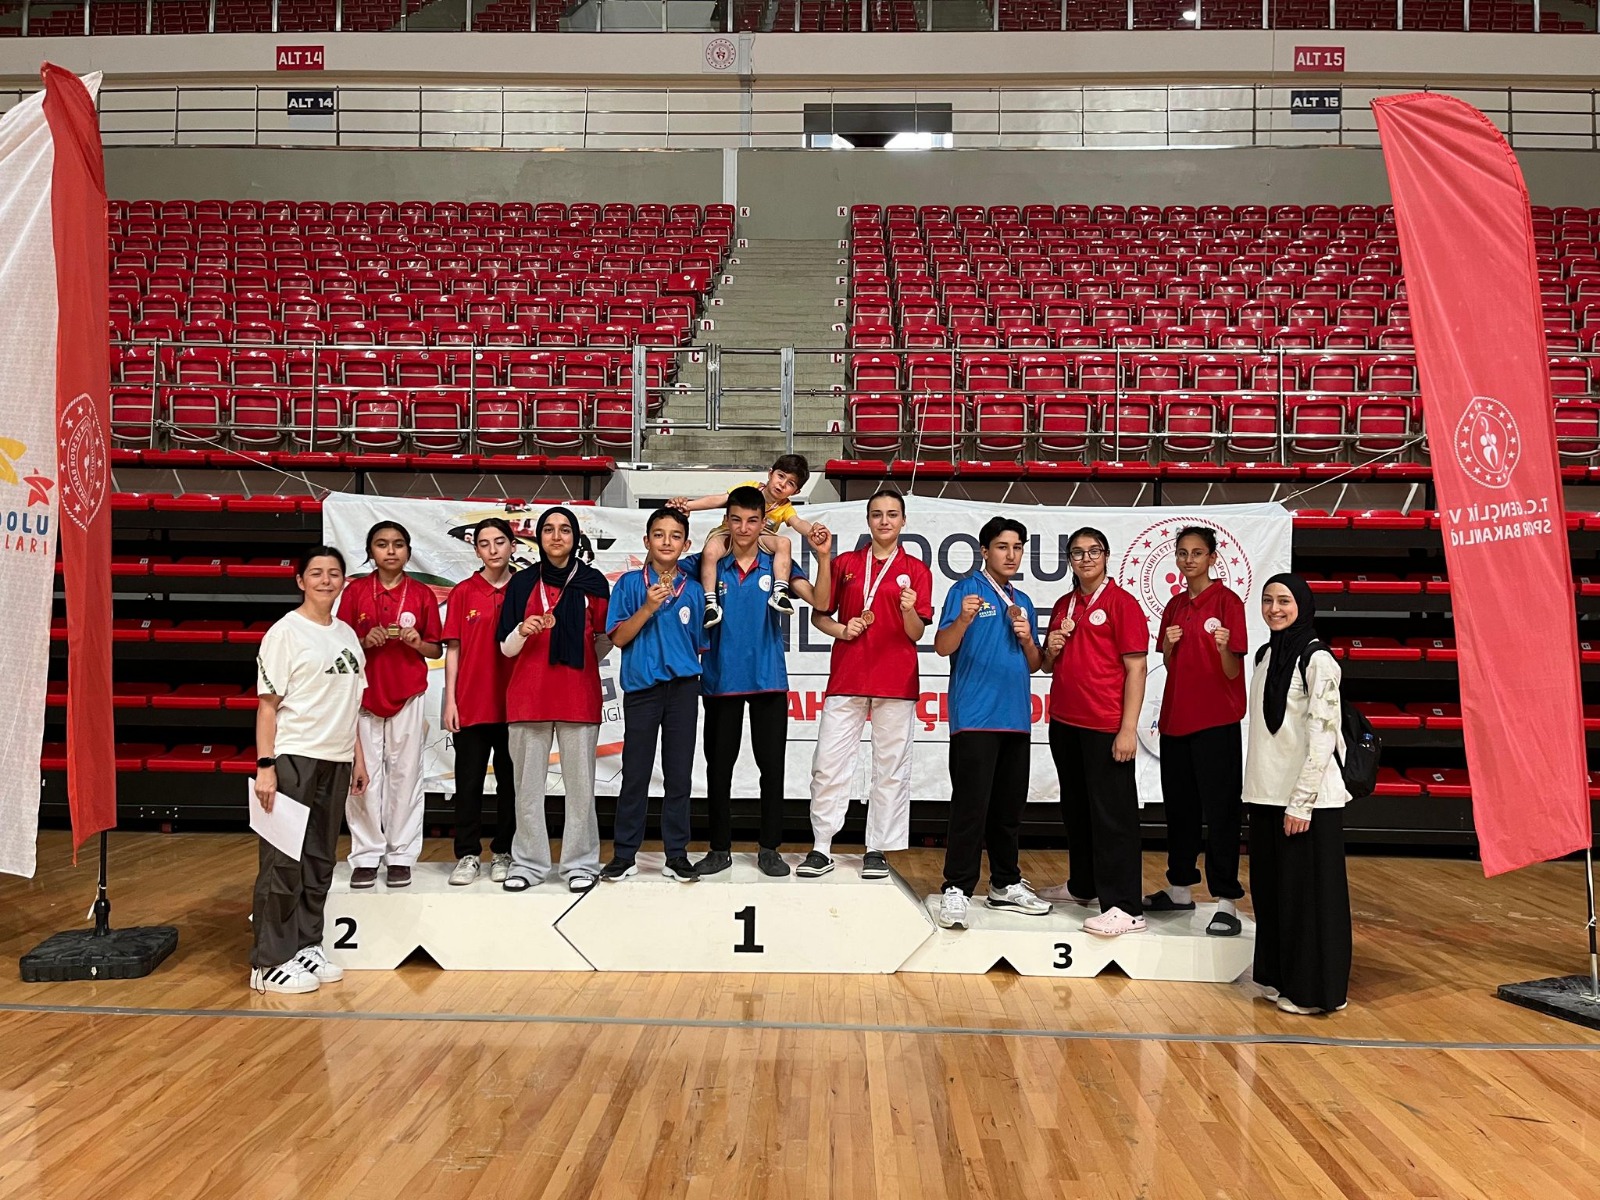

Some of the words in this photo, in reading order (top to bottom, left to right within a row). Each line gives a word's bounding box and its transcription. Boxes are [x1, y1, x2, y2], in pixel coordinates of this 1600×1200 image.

[278, 51, 302, 65] ALT
[305, 51, 322, 65] 14
[1296, 52, 1321, 66] ALT
[1324, 52, 1343, 66] 15
[288, 97, 314, 108] ALT
[318, 97, 333, 108] 14
[1292, 97, 1319, 107] ALT
[1323, 97, 1339, 107] 15
[0, 510, 49, 535] OLU
[333, 916, 358, 949] 2
[734, 905, 764, 953] 1
[1053, 942, 1073, 969] 3
